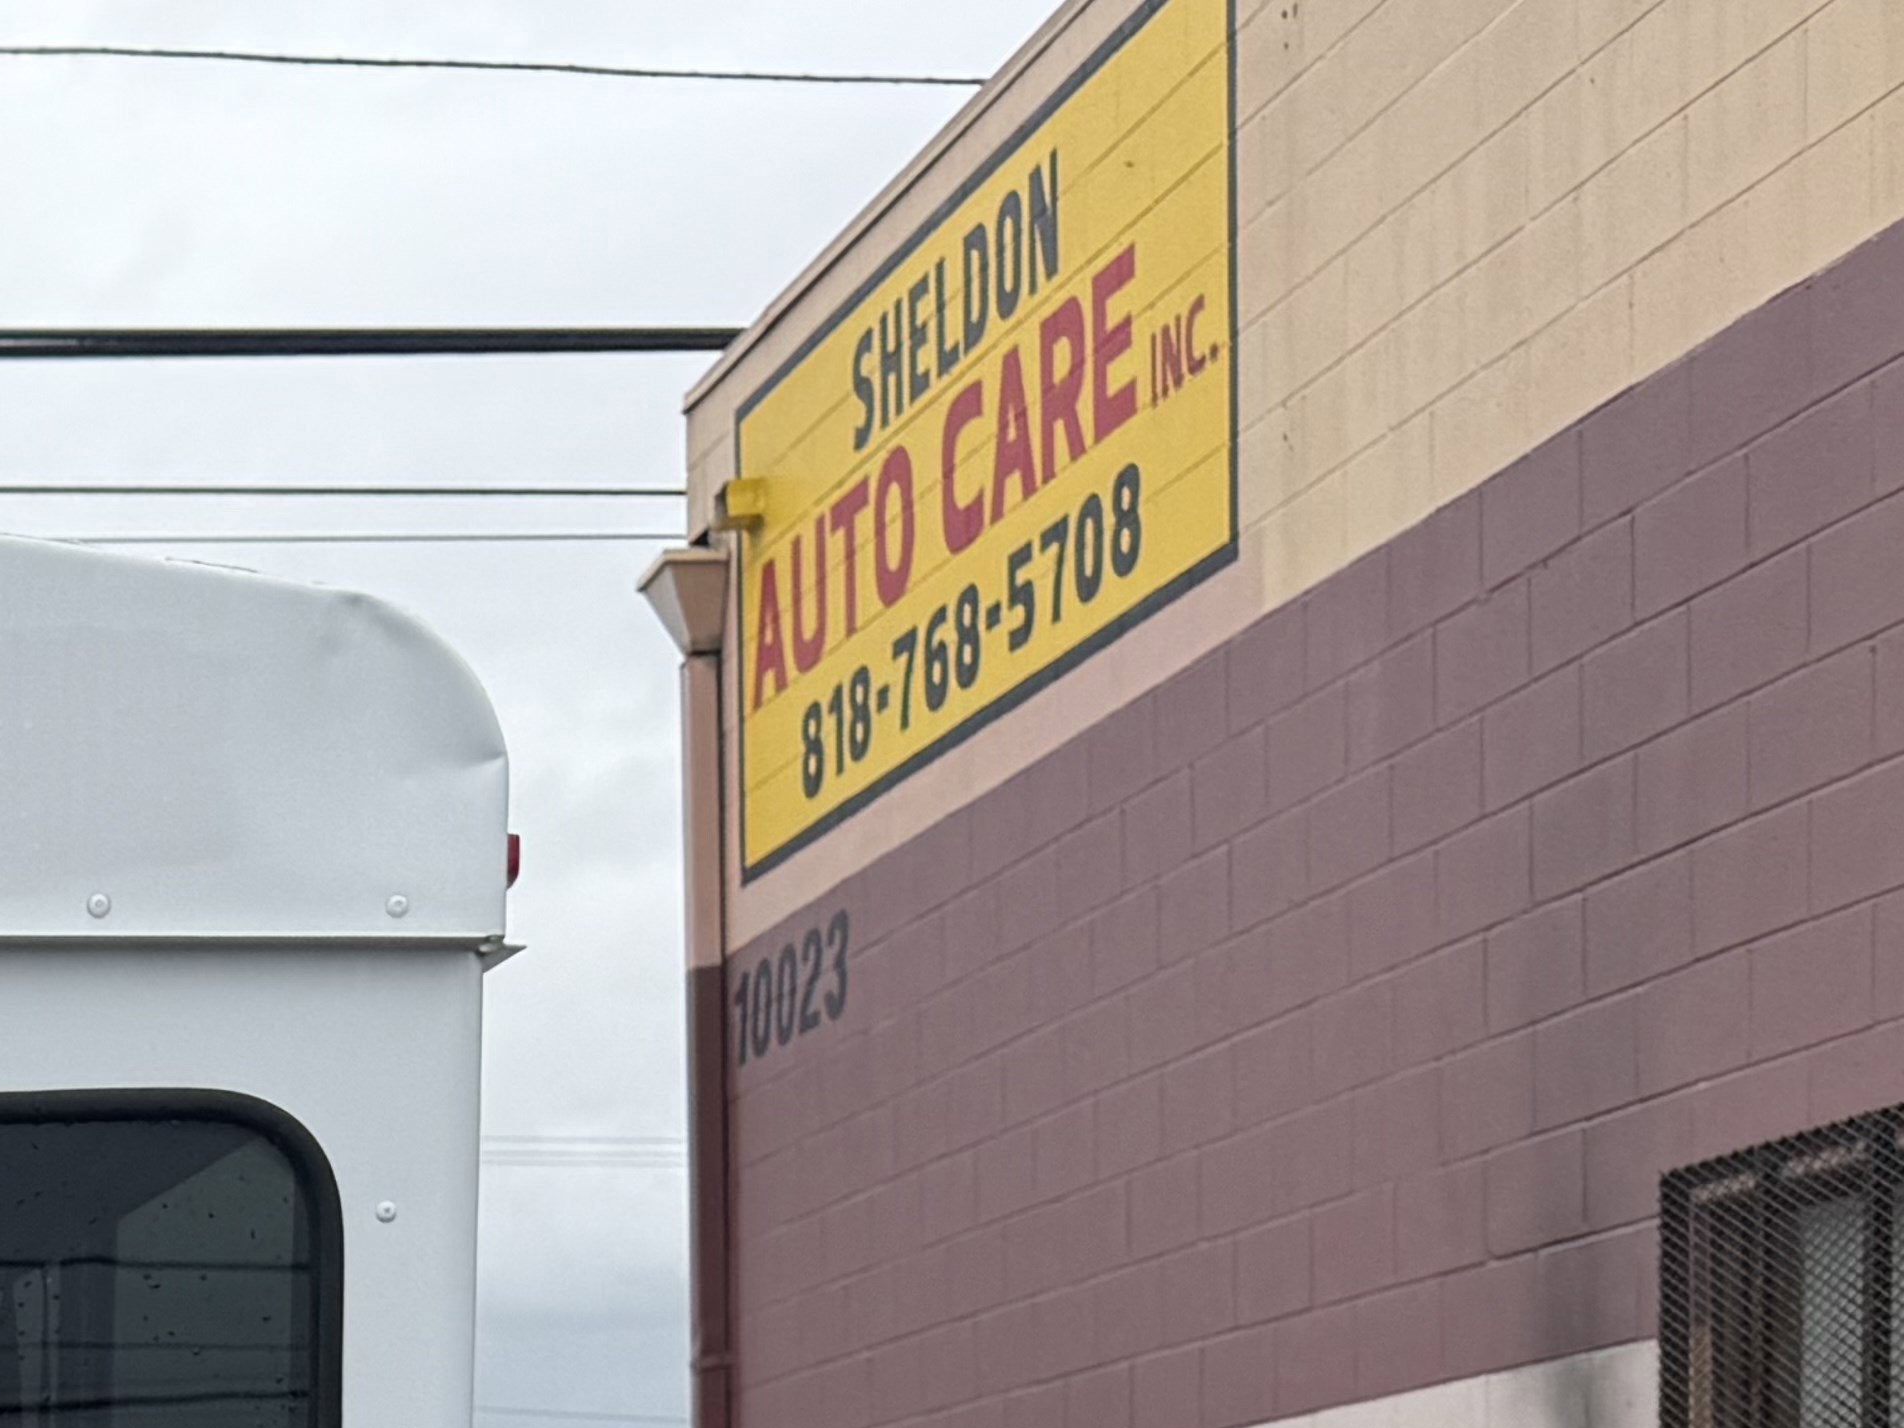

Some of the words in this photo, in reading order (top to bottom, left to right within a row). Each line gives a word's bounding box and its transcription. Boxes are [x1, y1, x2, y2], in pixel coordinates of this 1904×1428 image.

[853, 147, 1059, 452] SHELDON
[753, 444, 915, 715] AUTO
[941, 242, 1138, 556] CARE
[1151, 293, 1220, 409] INC.
[801, 462, 1141, 800] 818-768-5708
[734, 909, 849, 1067] 10023
